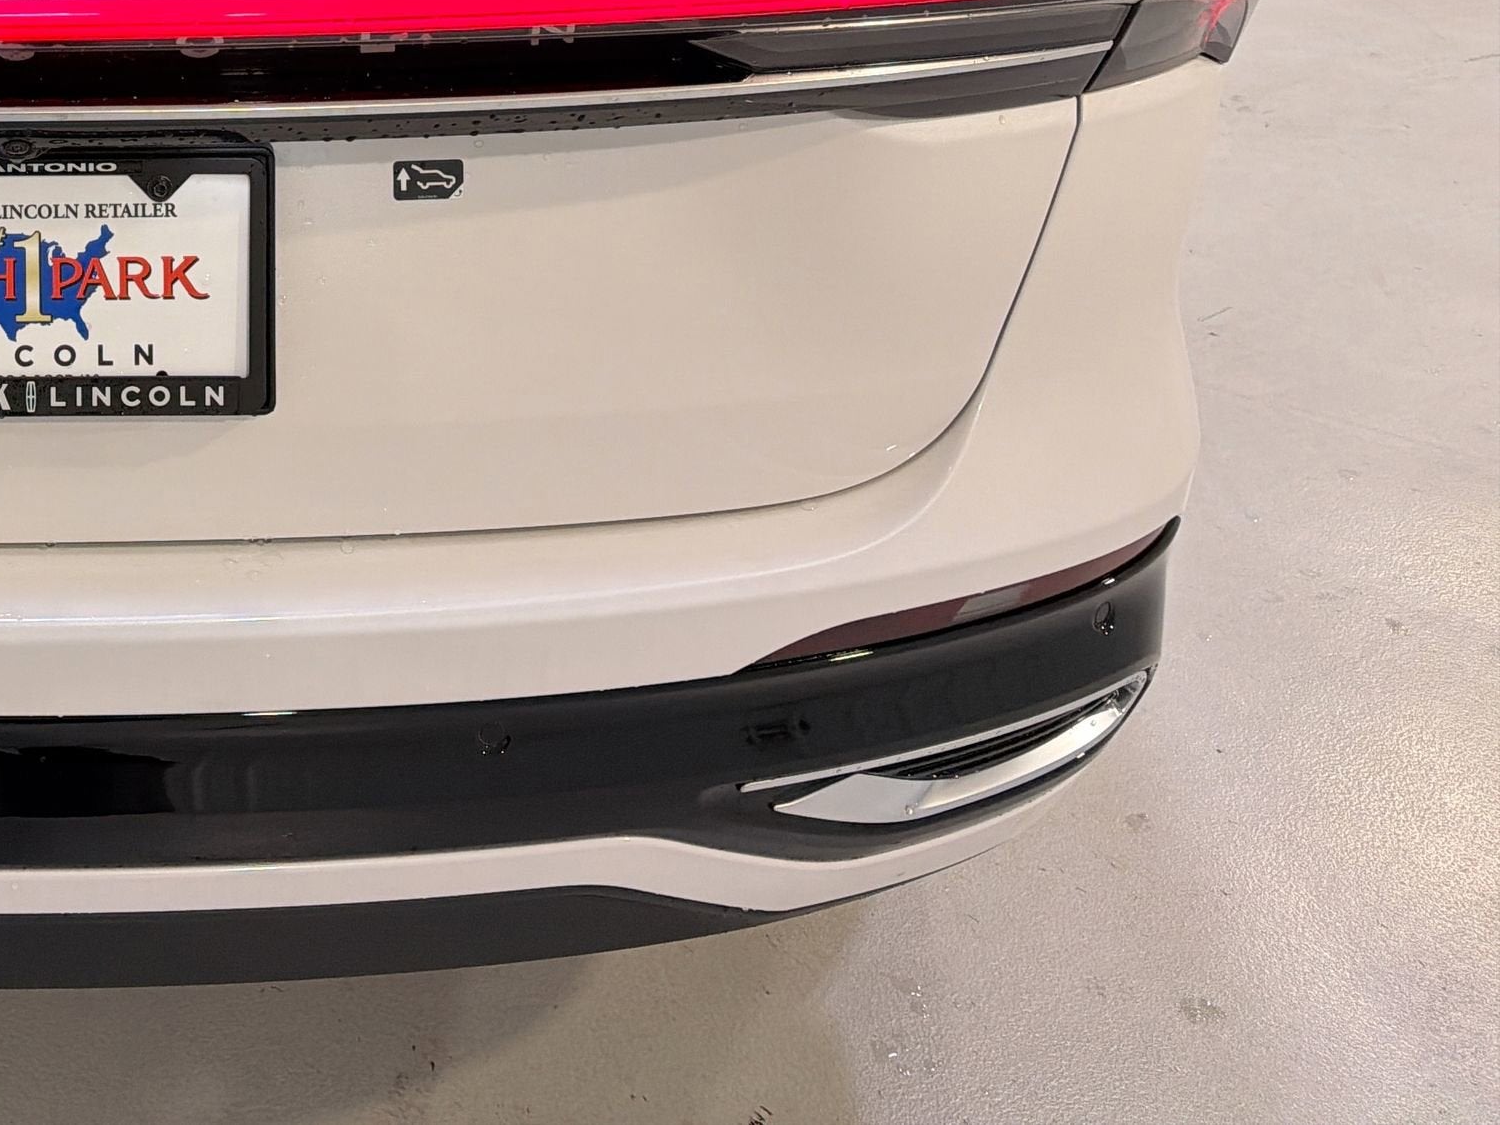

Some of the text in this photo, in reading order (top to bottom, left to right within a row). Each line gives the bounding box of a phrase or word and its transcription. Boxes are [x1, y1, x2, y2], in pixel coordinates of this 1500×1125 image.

[83, 203, 178, 219] RETAILER
[50, 255, 211, 301] PARK
[49, 385, 225, 408] LINCOLN
